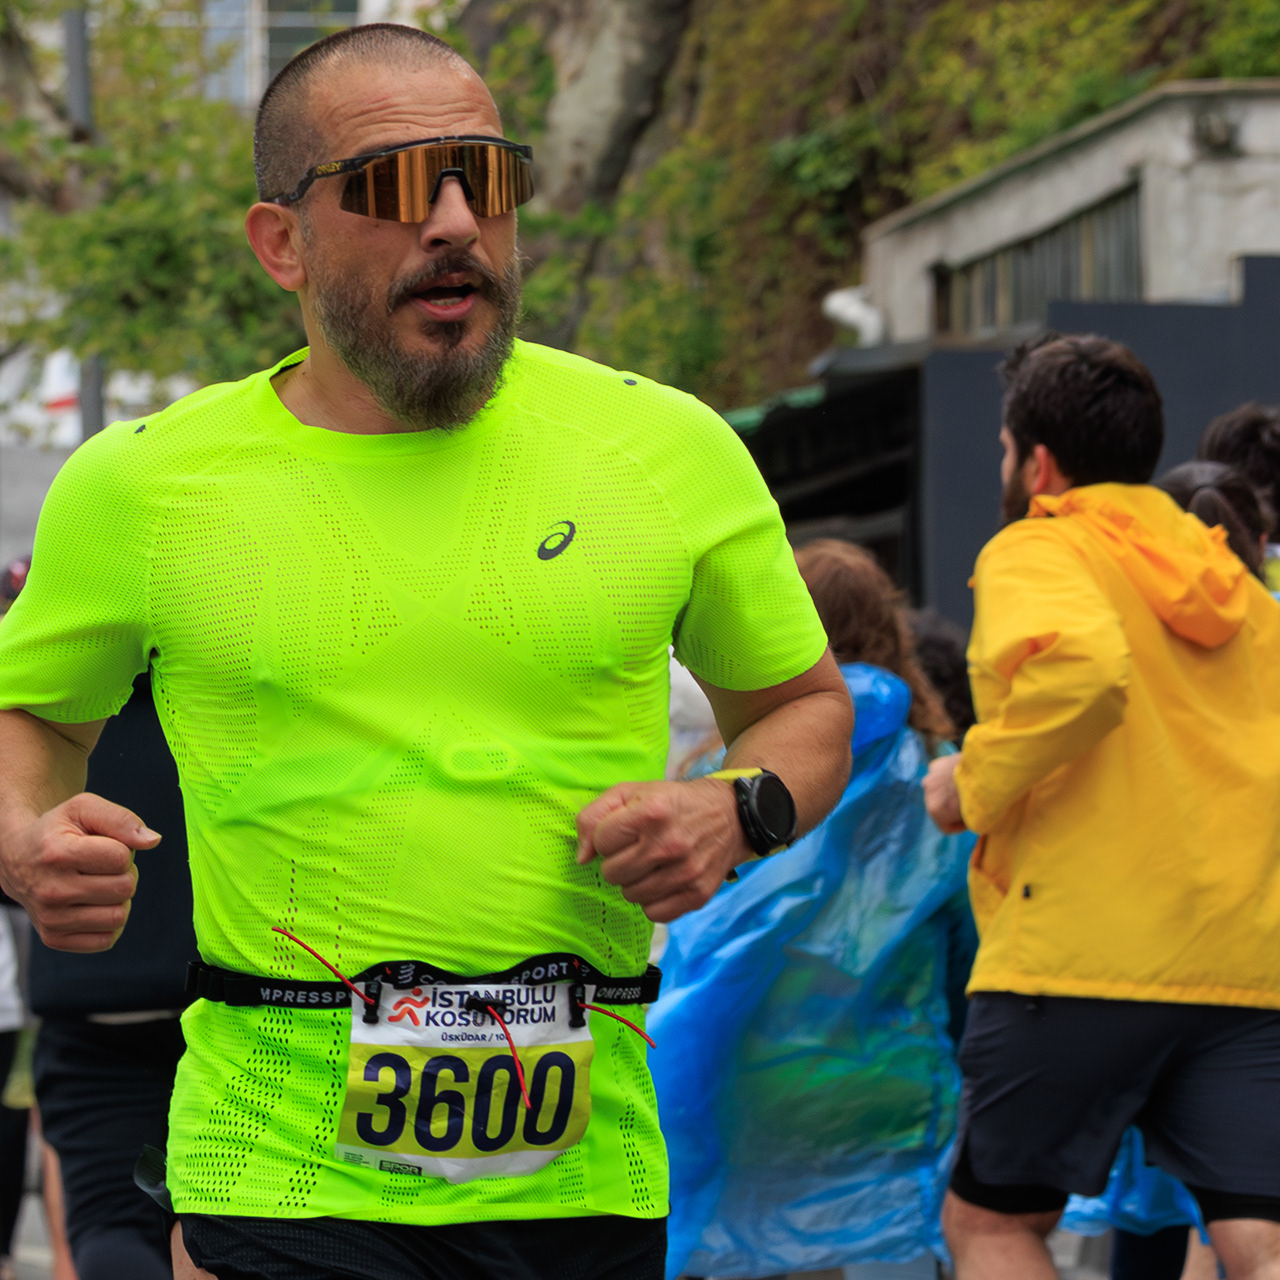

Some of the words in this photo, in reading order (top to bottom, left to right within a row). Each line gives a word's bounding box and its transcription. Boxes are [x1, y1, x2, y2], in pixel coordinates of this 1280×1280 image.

[441, 1032, 487, 1041] ÜSKÜDAR
[495, 1033, 509, 1041] 10
[356, 1051, 576, 1152] 3600
